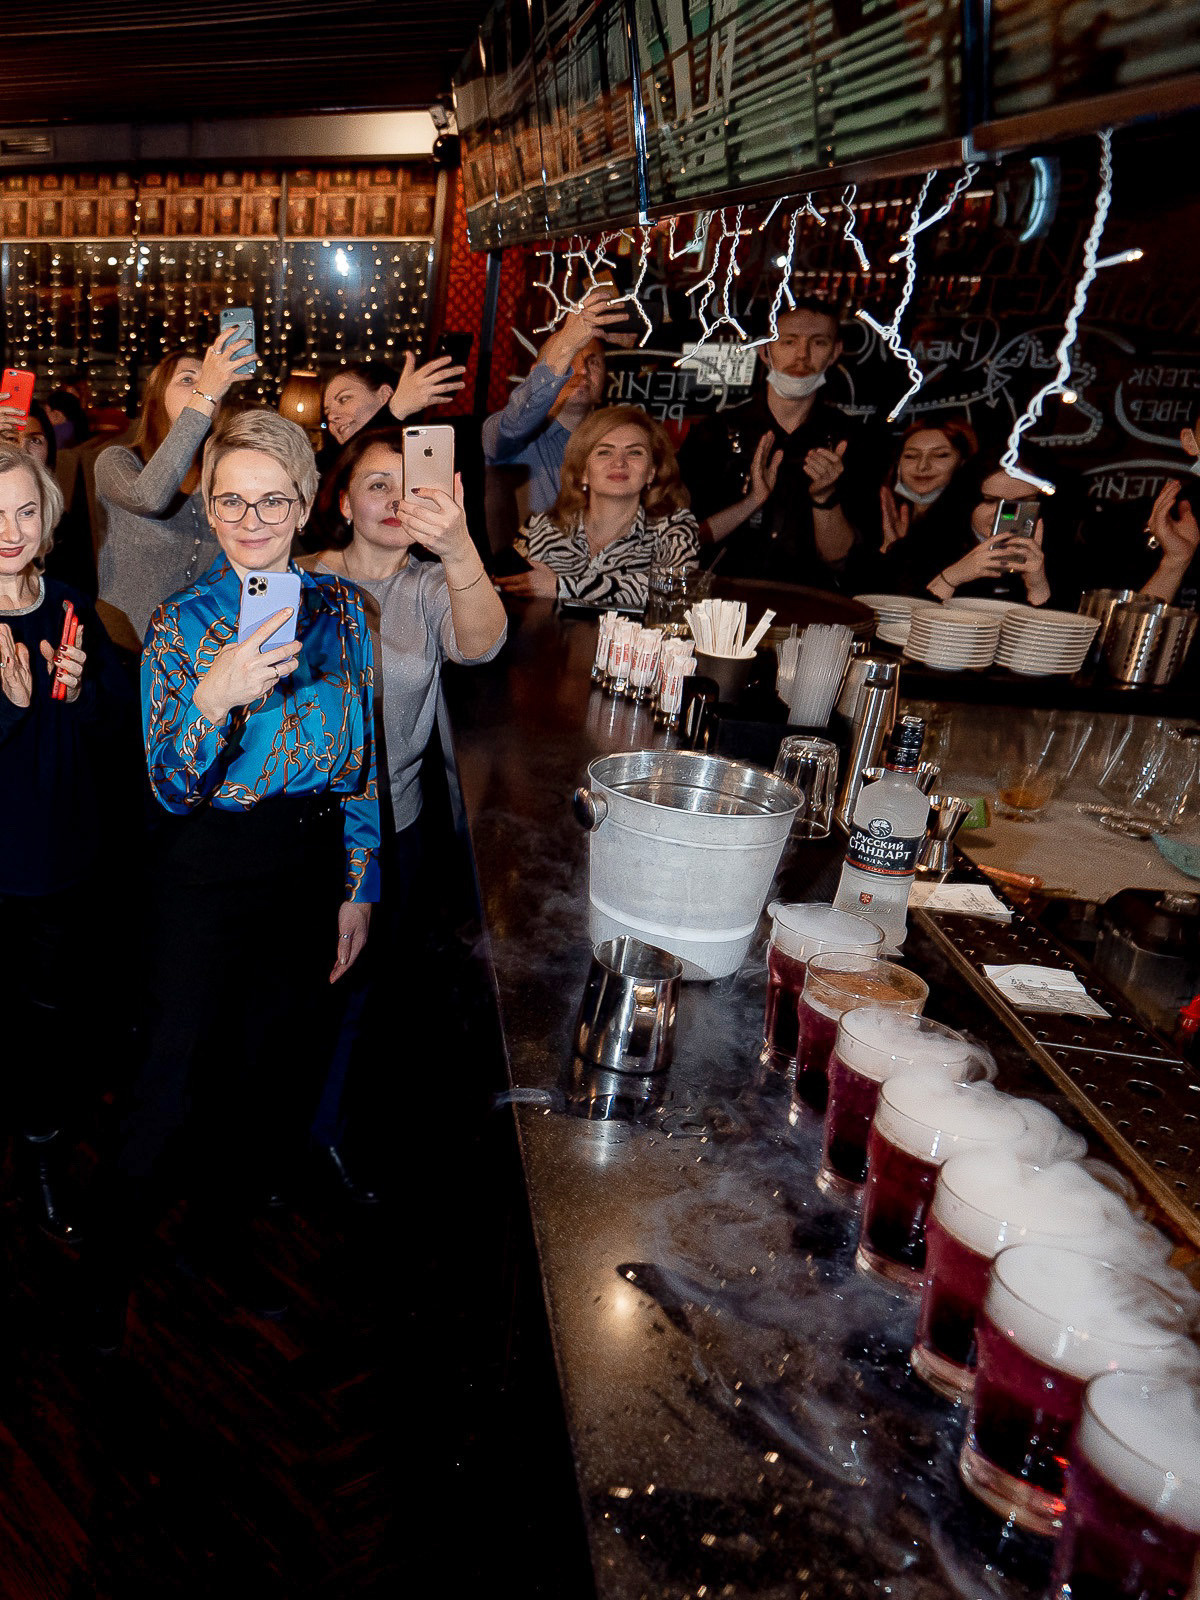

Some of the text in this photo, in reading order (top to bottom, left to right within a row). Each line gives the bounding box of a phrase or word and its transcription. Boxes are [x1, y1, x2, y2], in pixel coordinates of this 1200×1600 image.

[849, 835, 912, 861] СТАНДАРТ
[855, 831, 904, 851] РУССКИЙ
[857, 854, 891, 867] ВОДКА
